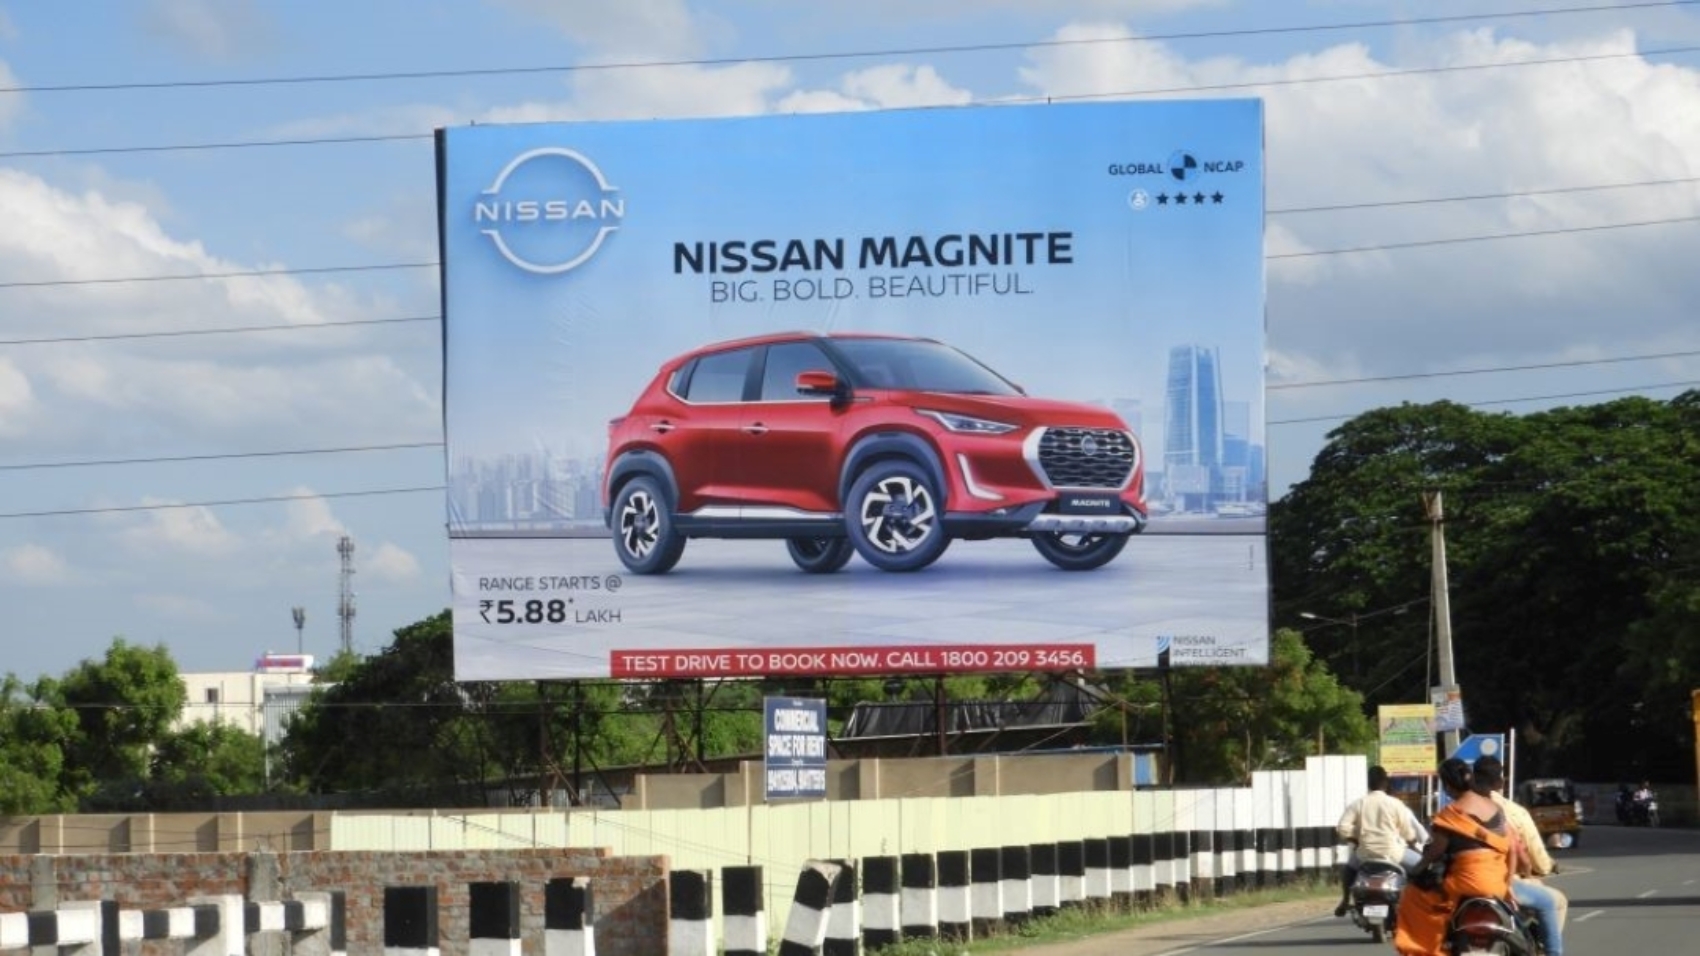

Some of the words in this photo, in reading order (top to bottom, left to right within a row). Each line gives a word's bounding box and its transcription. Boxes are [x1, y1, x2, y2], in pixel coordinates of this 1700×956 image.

[1108, 163, 1164, 176] GLOBAL
[1204, 160, 1244, 174] NCAP
[475, 199, 624, 222] NISSAN
[673, 239, 844, 274] NISSAN
[858, 231, 1074, 269] MAGNITE
[711, 280, 764, 302] BIG.
[773, 278, 859, 301] BOLD.
[869, 273, 1034, 298] BEAUTIFUL.
[479, 577, 534, 591] RANGE
[538, 575, 600, 590] STARTS
[605, 574, 622, 592] @
[575, 609, 622, 623] LAKH
[1173, 635, 1216, 644] NISSAN
[622, 656, 669, 671] TEST
[675, 655, 731, 670] DRIVE
[736, 654, 764, 669] TO
[769, 653, 826, 669] BOOK
[831, 652, 882, 668] NOW.
[887, 651, 936, 667] CALL
[940, 650, 988, 666] 1800
[993, 650, 1030, 666] 209
[1035, 649, 1088, 665] 3456.
